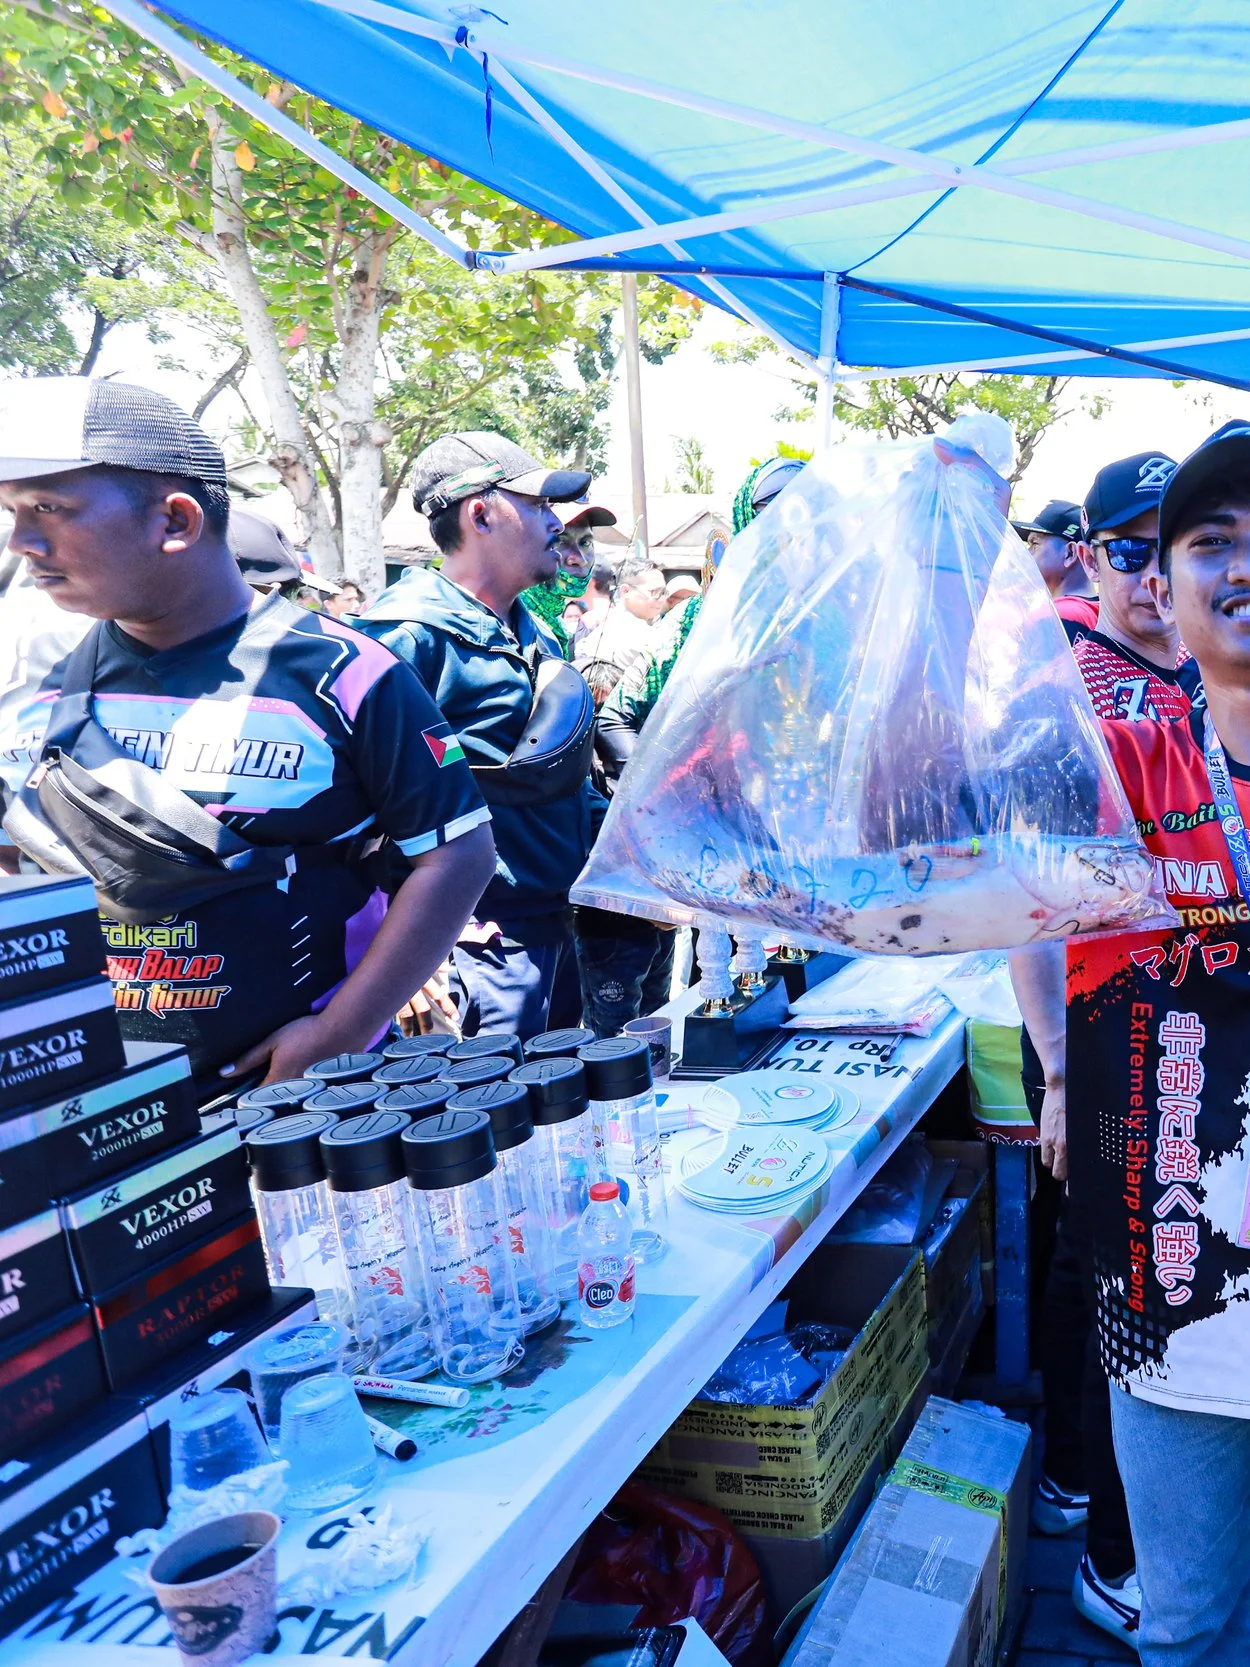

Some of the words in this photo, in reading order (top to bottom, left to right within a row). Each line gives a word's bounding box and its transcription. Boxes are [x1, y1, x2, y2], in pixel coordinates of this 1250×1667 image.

[184, 738, 304, 781] TIMUR
[1209, 754, 1231, 801] BULLET
[1153, 854, 1229, 899] UNA
[0, 928, 70, 961] EXOR
[138, 948, 224, 981] BALAP
[147, 981, 231, 1019] timur
[1122, 1002, 1153, 1132] Extremely
[77, 1100, 169, 1148] VEXOR
[786, 1151, 816, 1183] NUTICA
[1121, 1138, 1149, 1211] Sharp
[1153, 1010, 1206, 1308] 非常に鋭く強い
[119, 1176, 217, 1237] VEXOR
[1128, 1216, 1146, 1234] &
[589, 1282, 614, 1301] Cleo
[1126, 1238, 1147, 1313] Strong
[363, 1380, 394, 1390] SNOWMAN
[758, 1446, 776, 1454] CHEC
[744, 1481, 815, 1490] INDONESIA
[745, 1489, 818, 1499] PANCING
[780, 1513, 805, 1522] PLEASE
